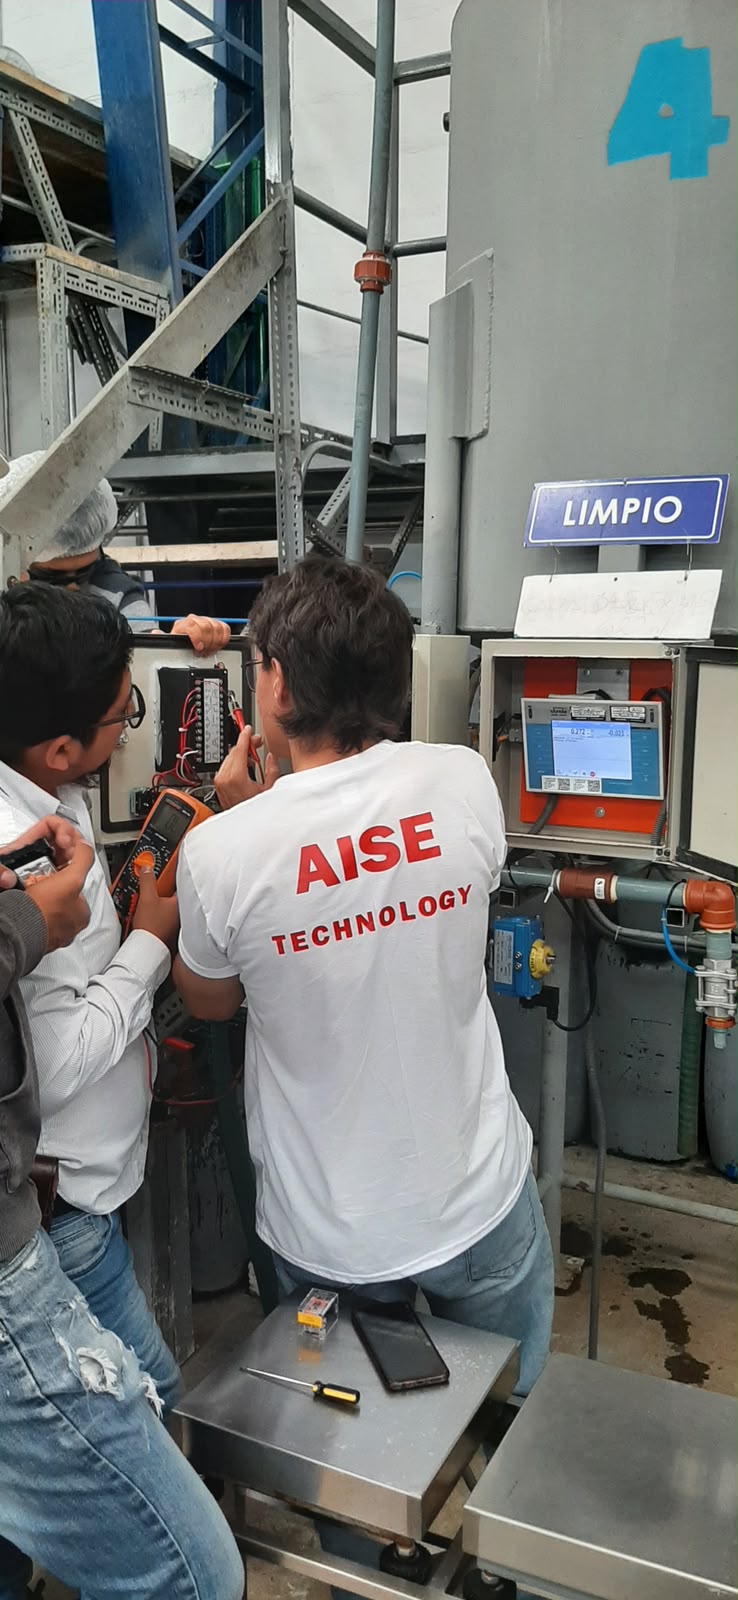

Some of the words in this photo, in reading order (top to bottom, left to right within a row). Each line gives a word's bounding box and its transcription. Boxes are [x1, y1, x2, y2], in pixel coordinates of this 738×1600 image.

[606, 37, 730, 181] 4
[563, 496, 682, 526] LIMPIO
[296, 811, 442, 894] AISE
[271, 884, 472, 955] TECHNOLOGY
